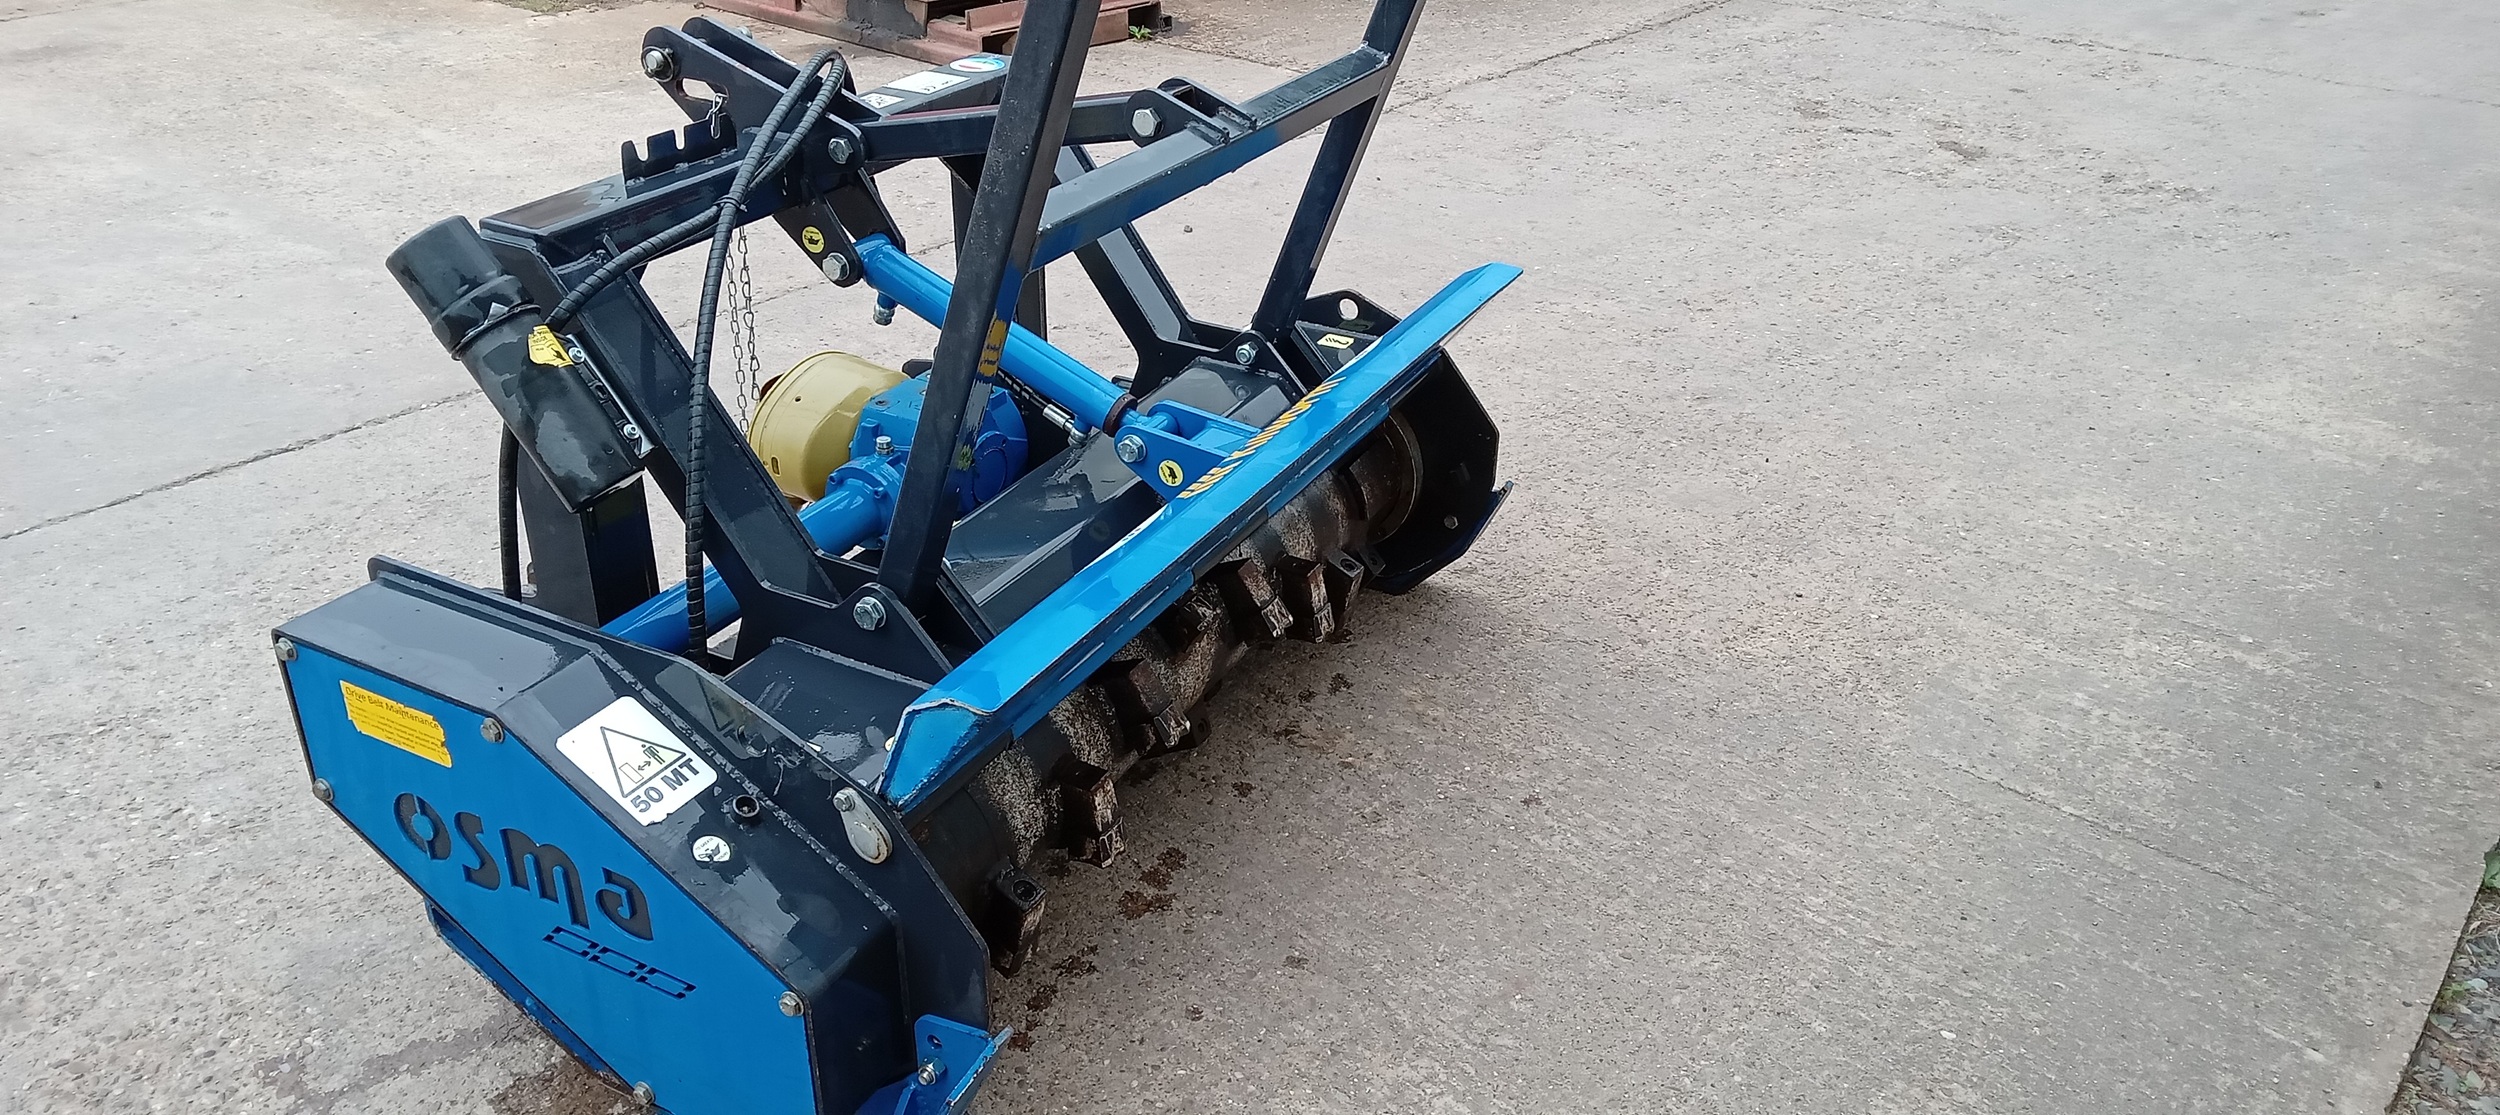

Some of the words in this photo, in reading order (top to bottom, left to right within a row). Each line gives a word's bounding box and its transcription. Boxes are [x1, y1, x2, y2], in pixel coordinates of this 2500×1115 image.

[345, 686, 366, 702] Drive
[384, 703, 440, 730] Maintenance
[630, 786, 664, 813] 50
[660, 757, 700, 791] MT
